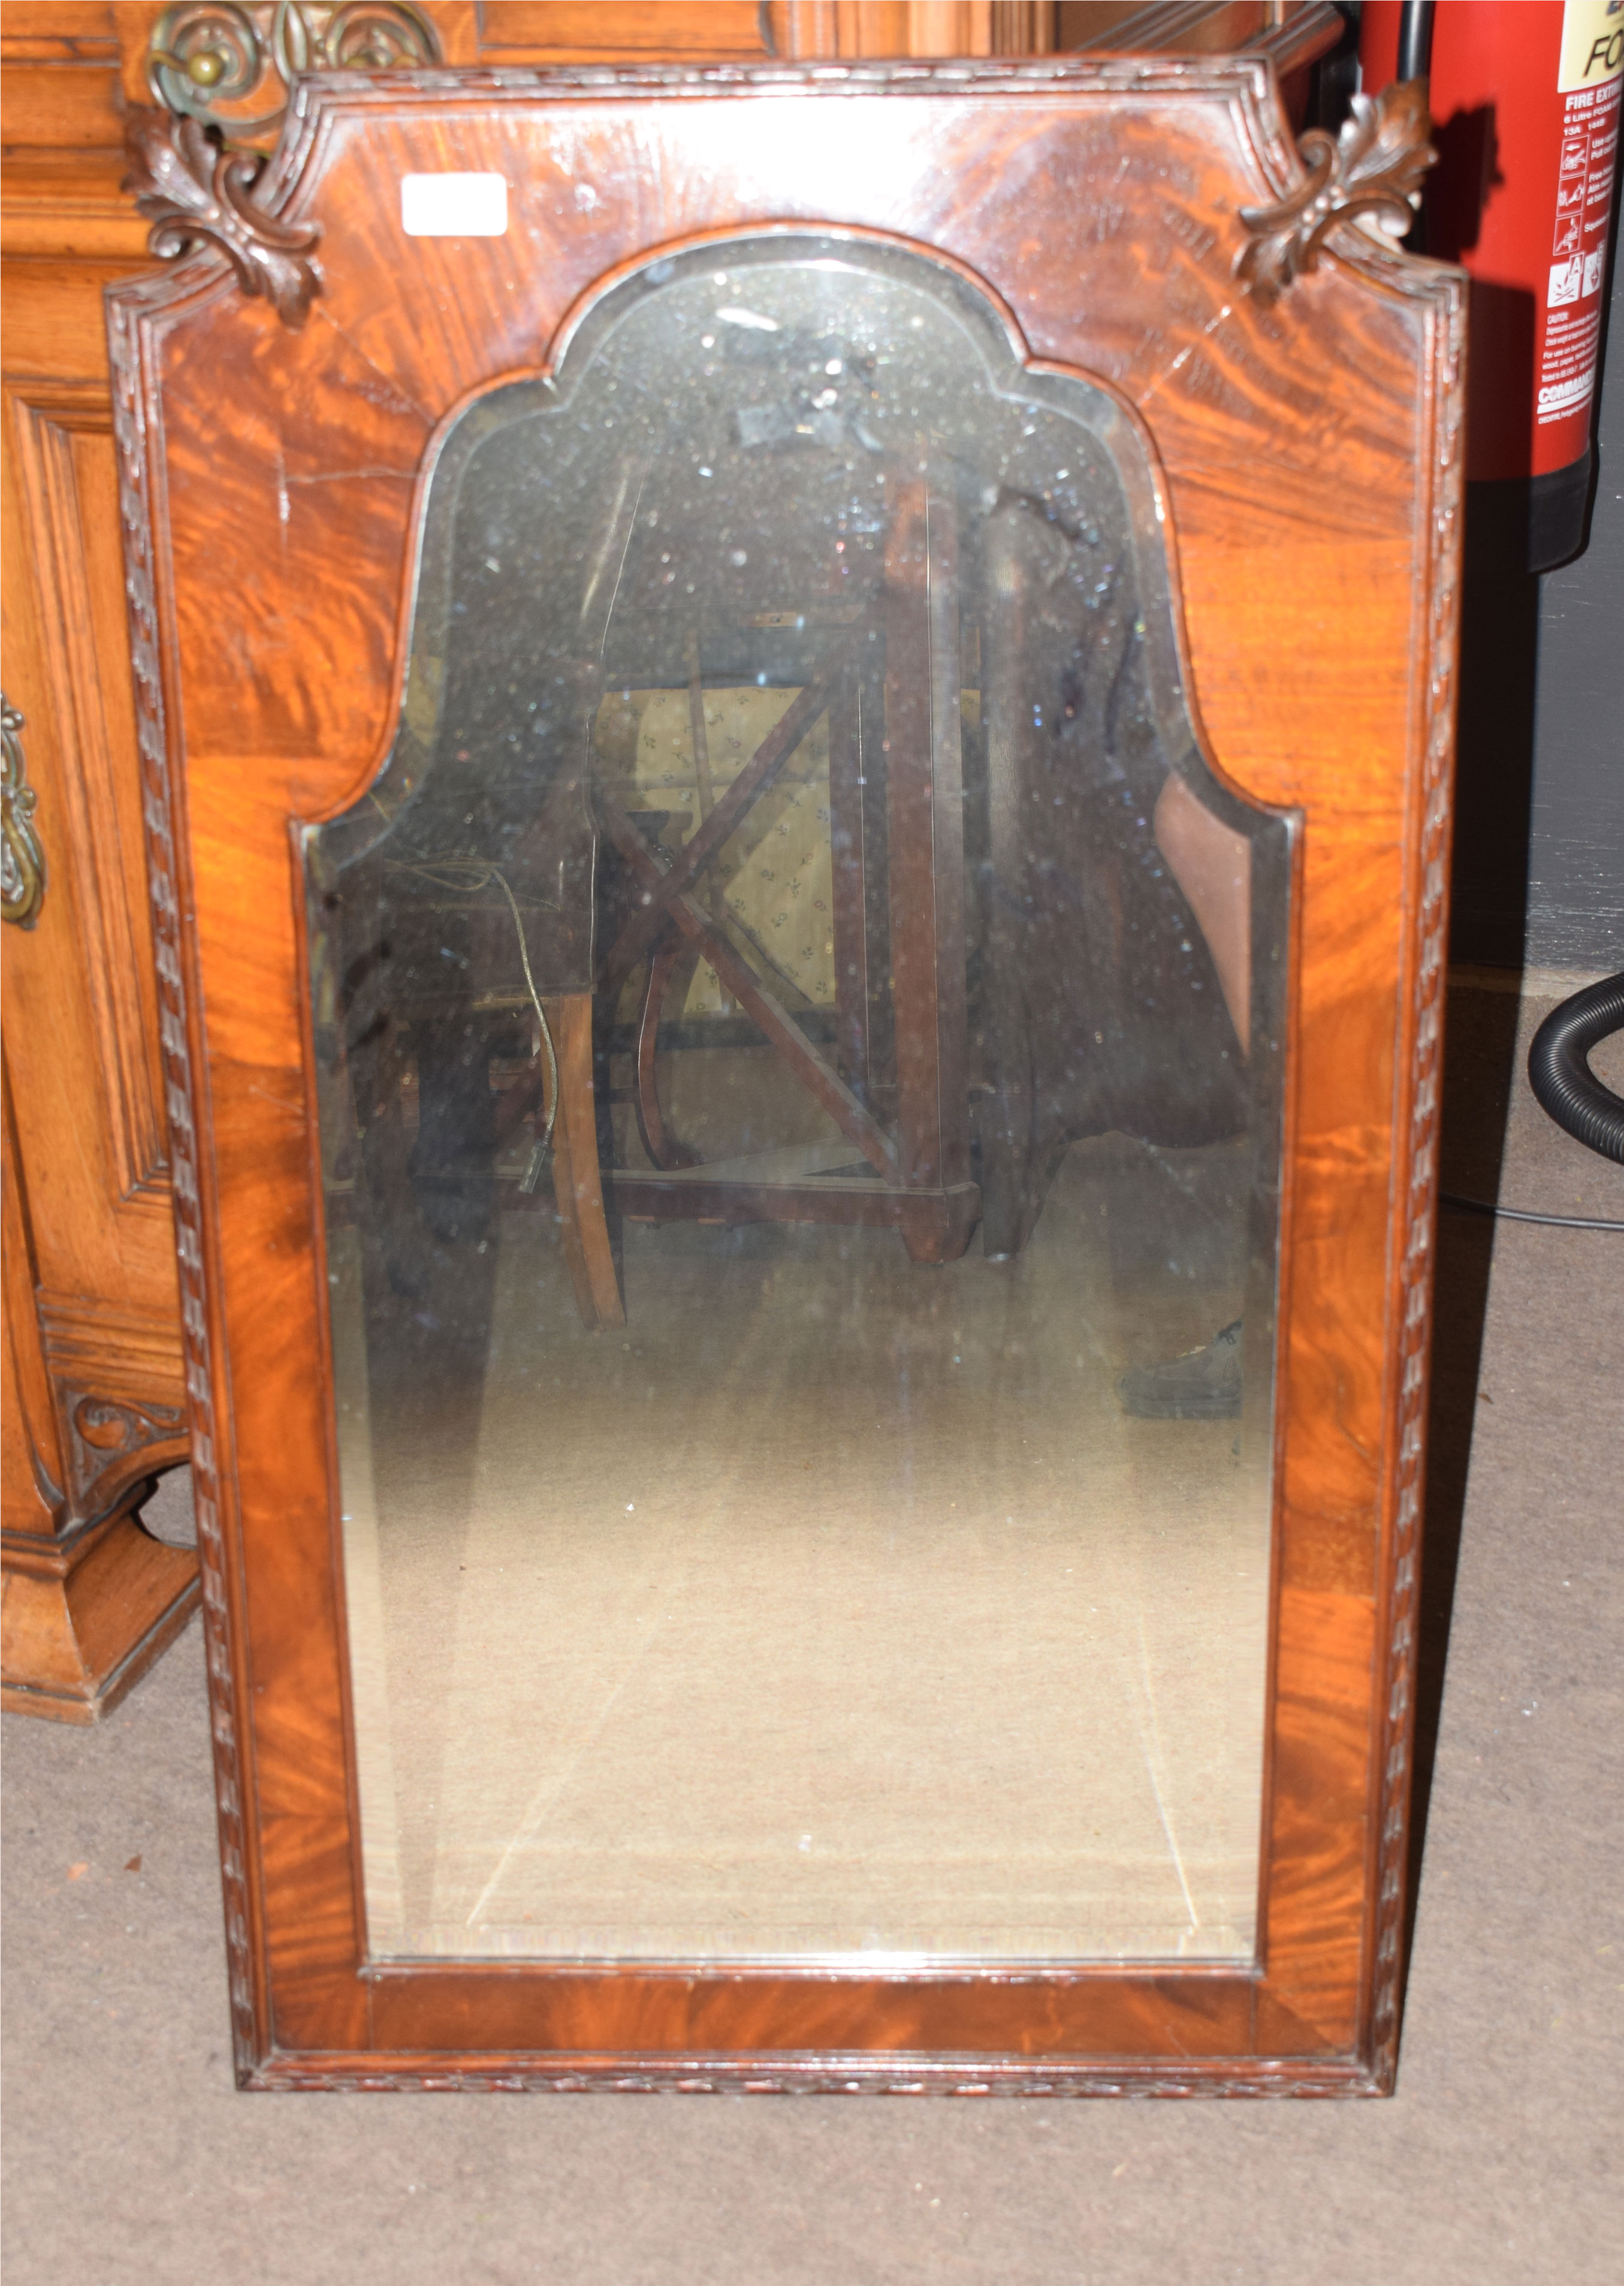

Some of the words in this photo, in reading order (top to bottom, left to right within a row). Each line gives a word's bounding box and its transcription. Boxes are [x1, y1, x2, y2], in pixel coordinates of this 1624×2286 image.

[1565, 92, 1594, 111] FIRE
[1563, 115, 1571, 124] 6
[1572, 111, 1592, 122] Litre
[1593, 102, 1612, 117] FOAM
[1563, 126, 1581, 137] 13A
[1592, 137, 1604, 149] Use
[1590, 147, 1603, 161] Pull
[1570, 256, 1581, 275] A
